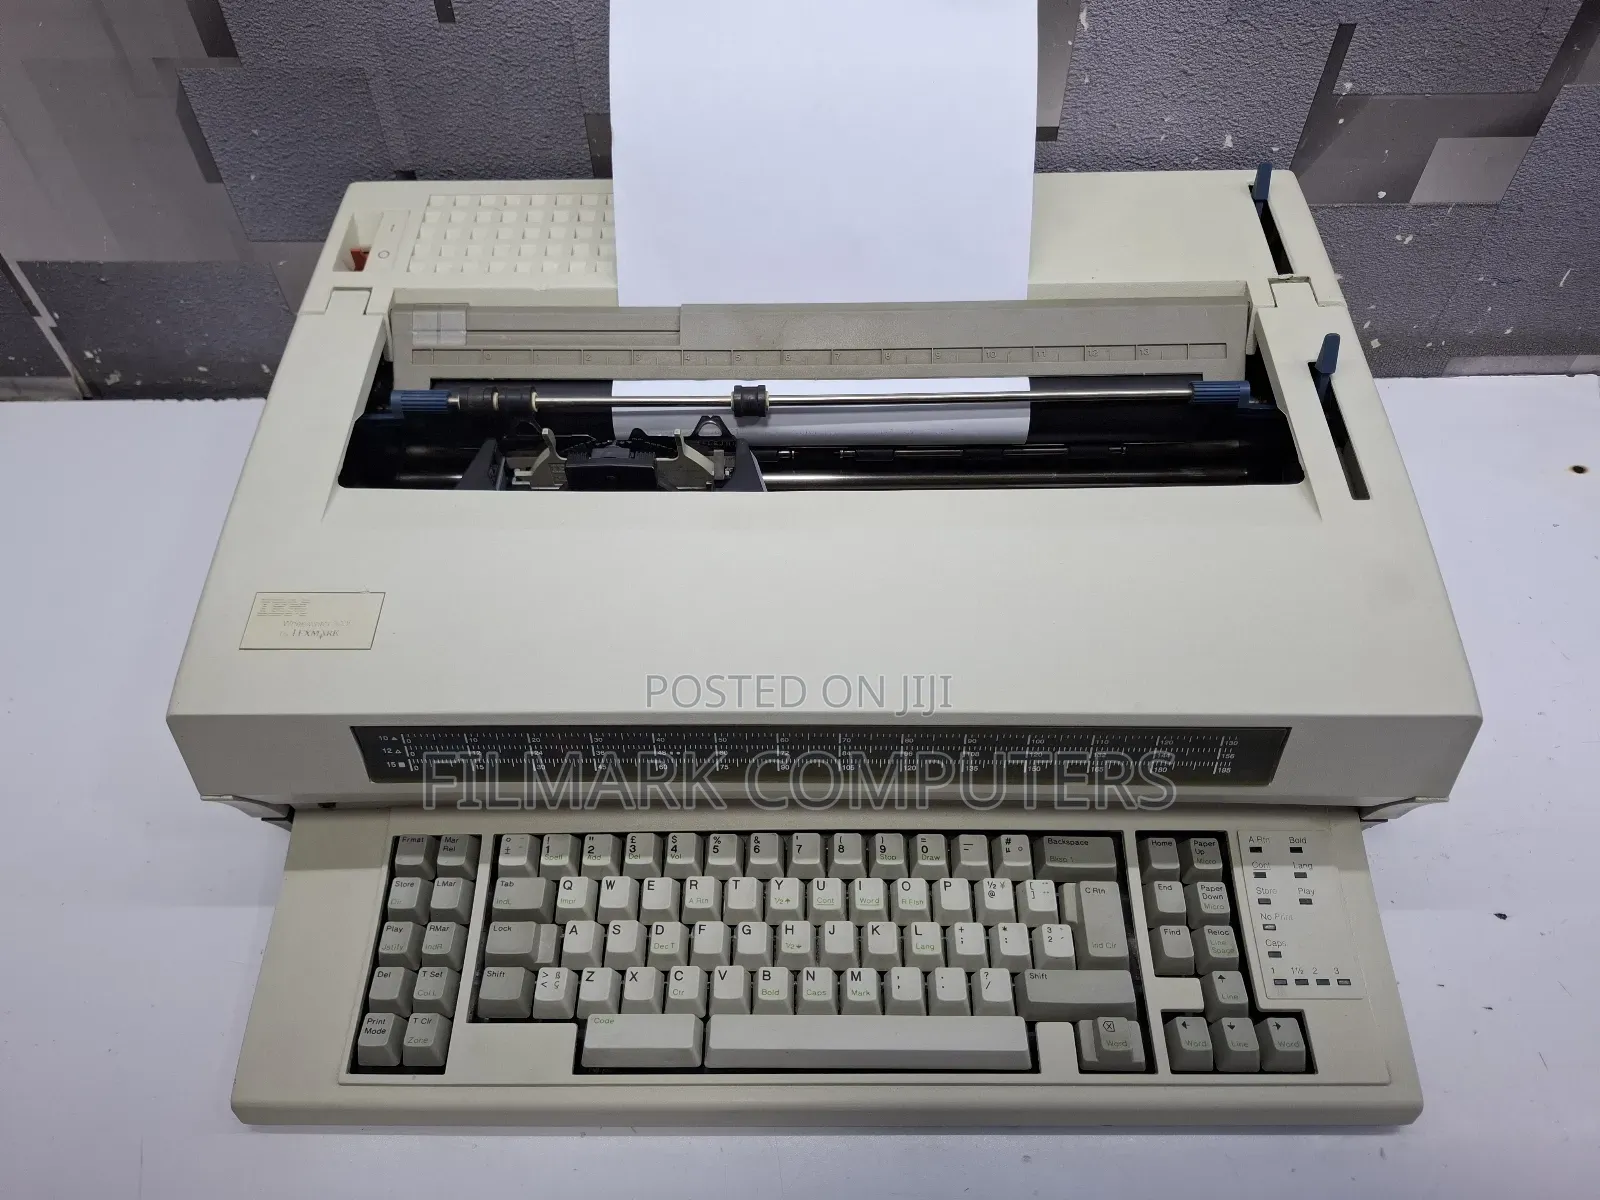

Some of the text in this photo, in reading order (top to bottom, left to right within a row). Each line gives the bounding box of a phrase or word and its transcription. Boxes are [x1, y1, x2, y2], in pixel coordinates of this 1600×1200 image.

[671, 835, 678, 844] $
[713, 836, 722, 844] %
[753, 836, 761, 844] &
[1047, 838, 1089, 846] Backspace
[1193, 840, 1216, 848] Paper
[545, 846, 551, 854] 1
[587, 846, 595, 854] 2
[629, 845, 637, 853] 3
[670, 845, 678, 853] 4
[712, 845, 719, 854] 5
[753, 845, 761, 854] 6
[796, 845, 803, 854] 7
[838, 845, 845, 853] 8
[879, 845, 886, 854] 9
[1195, 848, 1205, 857] Up
[544, 853, 563, 861] Spell
[587, 853, 602, 861] Add
[880, 854, 896, 862] Stop
[1293, 861, 1314, 870] Lang
[394, 880, 415, 888] Store
[500, 880, 515, 888] Tab
[563, 880, 573, 891] Q
[605, 880, 616, 890] W
[647, 881, 655, 890] E
[690, 880, 698, 890] R
[732, 880, 741, 890] T
[775, 880, 784, 890] Y
[816, 881, 826, 891] U
[858, 880, 862, 891] I
[901, 881, 911, 891] O
[943, 881, 952, 891] P
[1158, 883, 1173, 891] End
[1092, 887, 1106, 895] Rtn
[1200, 885, 1223, 893] Paper
[1256, 887, 1278, 895] Store
[1298, 887, 1315, 896] Play
[987, 890, 996, 898] @
[816, 896, 835, 905] Cont
[860, 897, 880, 905] Word
[1274, 913, 1294, 921] Print
[386, 925, 403, 933] Play
[568, 925, 578, 935] A
[612, 925, 621, 935] S
[655, 925, 665, 935] D
[698, 925, 706, 935] F
[742, 925, 752, 935] G
[785, 925, 794, 935] H
[828, 925, 835, 935] J
[871, 925, 881, 936] K
[915, 925, 923, 936] L
[653, 942, 668, 950] Dec
[915, 943, 935, 951] Lang
[1209, 939, 1227, 947] Line
[1265, 939, 1287, 948] Caps
[377, 970, 391, 978] Del
[430, 970, 443, 978] Set
[486, 970, 505, 978] Shift
[585, 971, 595, 981] Z
[629, 971, 638, 981] X
[674, 971, 684, 981] C
[718, 970, 727, 980] V
[763, 971, 771, 981] B
[806, 971, 815, 981] N
[850, 971, 862, 981] M
[1029, 972, 1048, 980] Shift
[762, 988, 780, 996] Bold
[806, 989, 827, 997] Caps
[851, 988, 871, 996] Mark
[1222, 992, 1239, 1000] Line
[367, 1017, 386, 1026] Print
[420, 1017, 433, 1025] Clr
[593, 1017, 614, 1025] Code
[364, 1027, 387, 1035] Mode
[407, 1036, 429, 1044] Zone
[1106, 1039, 1127, 1047] Word
[1231, 1040, 1249, 1048] Line
